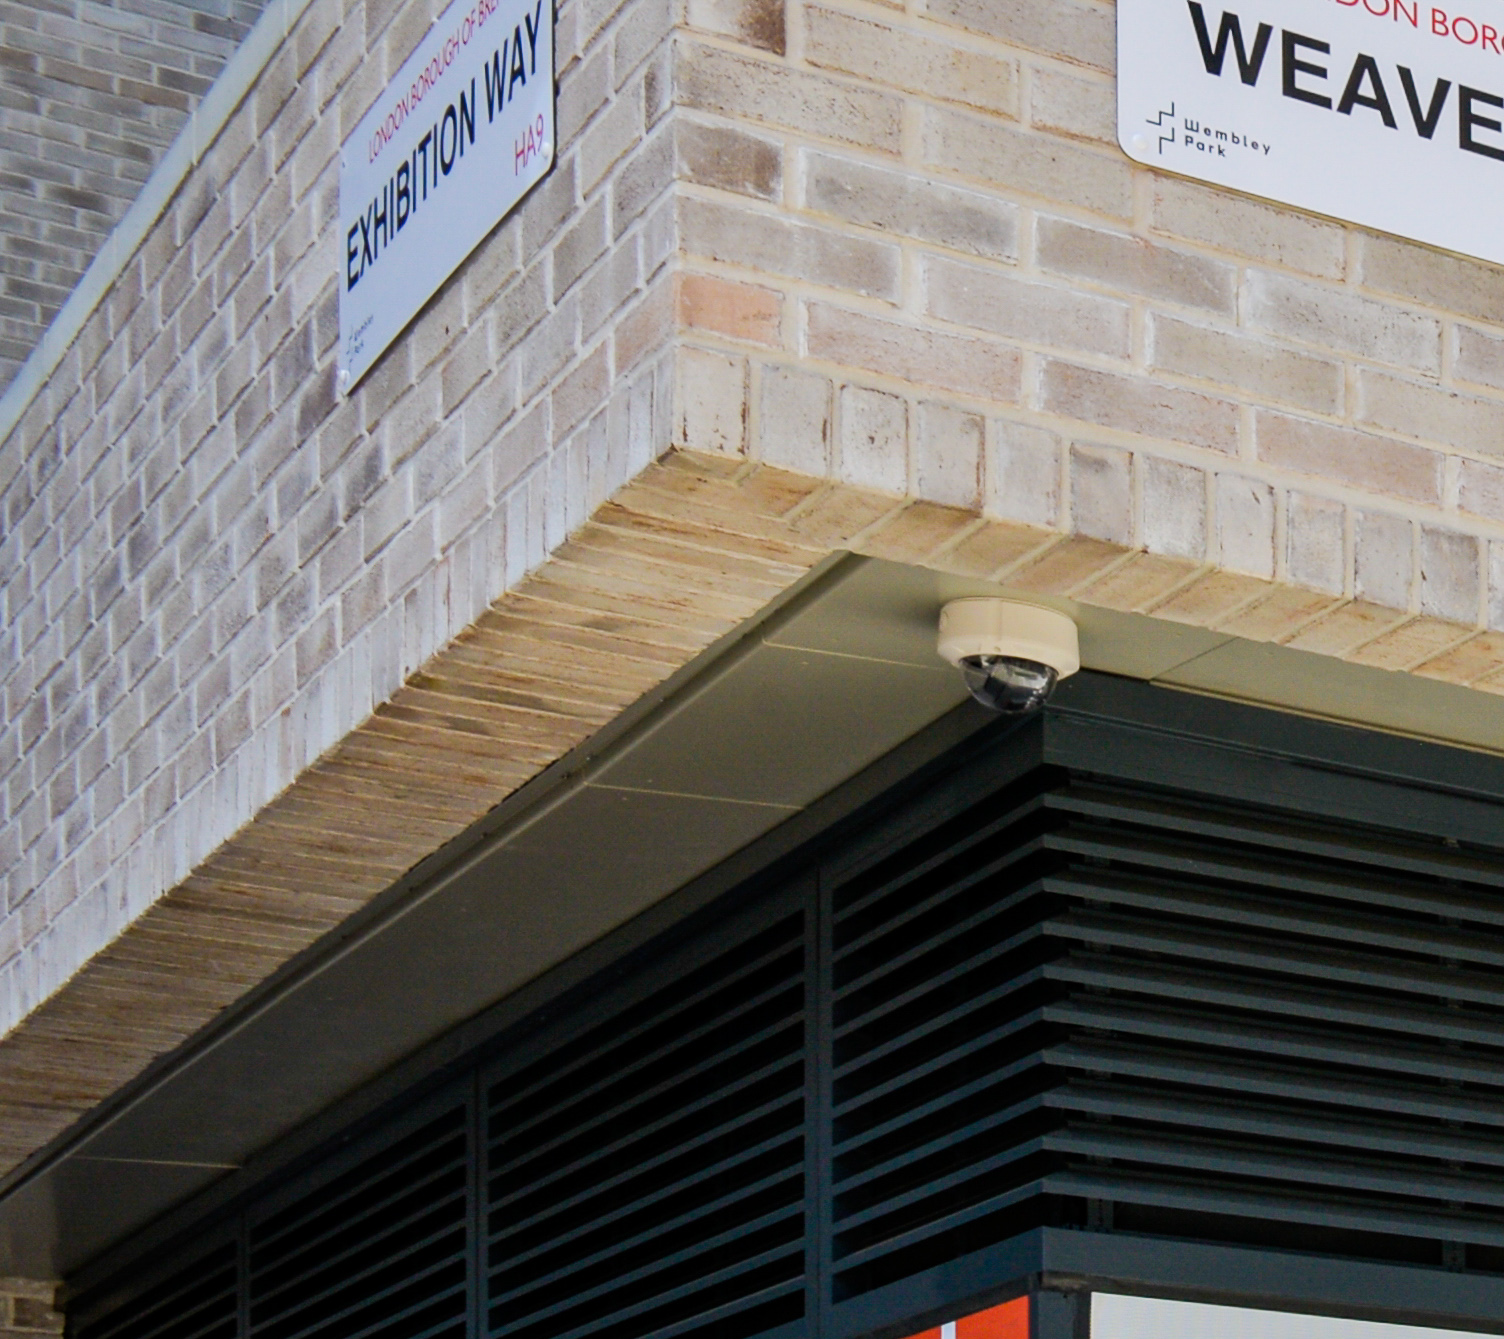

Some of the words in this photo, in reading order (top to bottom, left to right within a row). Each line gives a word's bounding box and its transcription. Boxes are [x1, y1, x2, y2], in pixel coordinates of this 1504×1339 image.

[368, 92, 411, 164] LONDON
[411, 29, 460, 109] BOROUGH
[461, 9, 476, 45] OF
[347, 78, 475, 292] EXHIBITION
[484, 0, 542, 123] WAY
[515, 112, 544, 176] HA9
[1185, 118, 1270, 155] Wembley
[1185, 135, 1225, 157] Park
